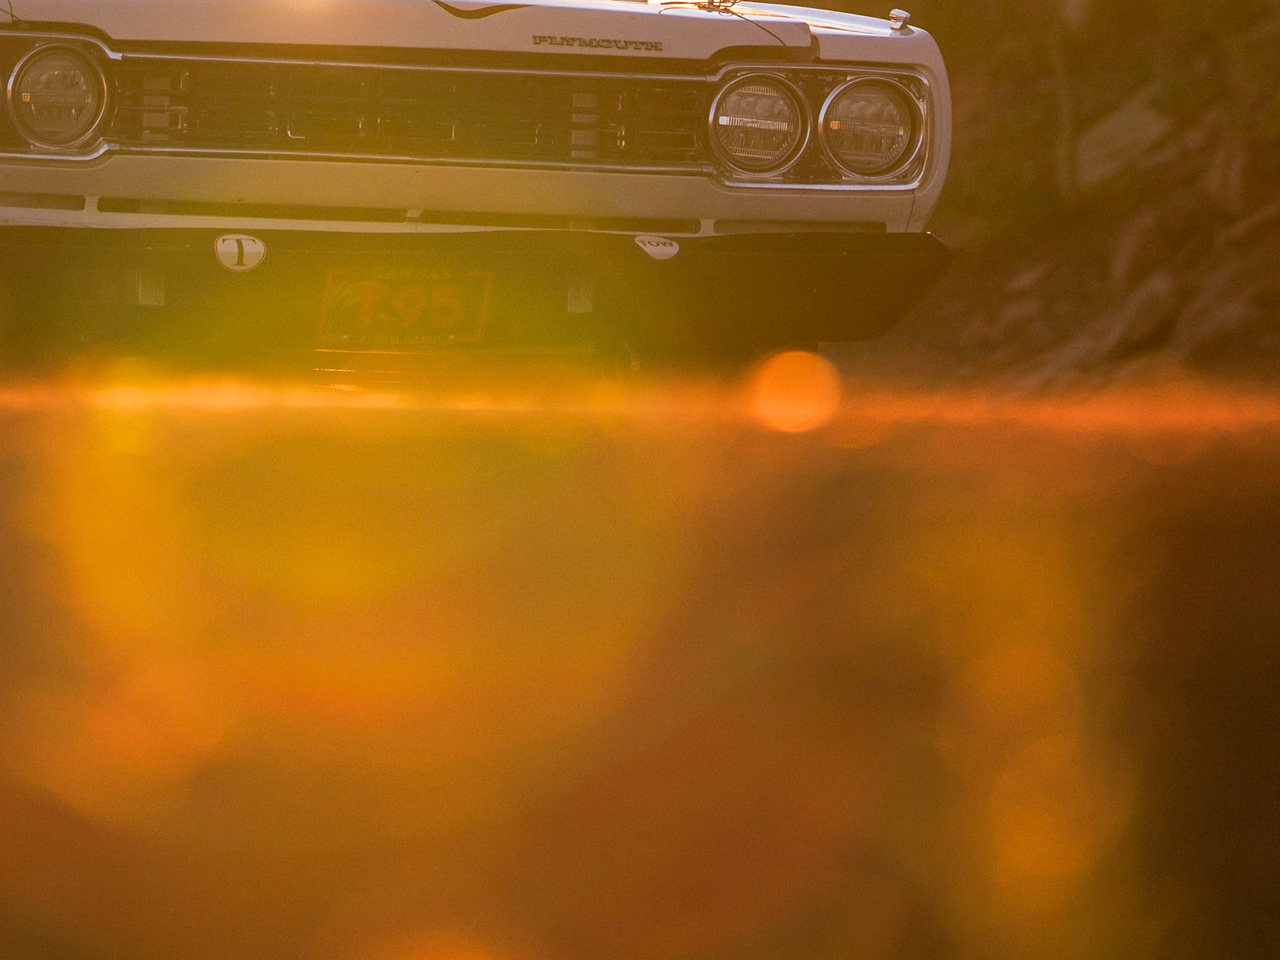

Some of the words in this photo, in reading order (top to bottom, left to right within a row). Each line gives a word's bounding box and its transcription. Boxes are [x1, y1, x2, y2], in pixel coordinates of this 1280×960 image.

[532, 35, 664, 52] PLYMOUTH
[637, 239, 674, 248] TOW
[221, 238, 258, 267] T
